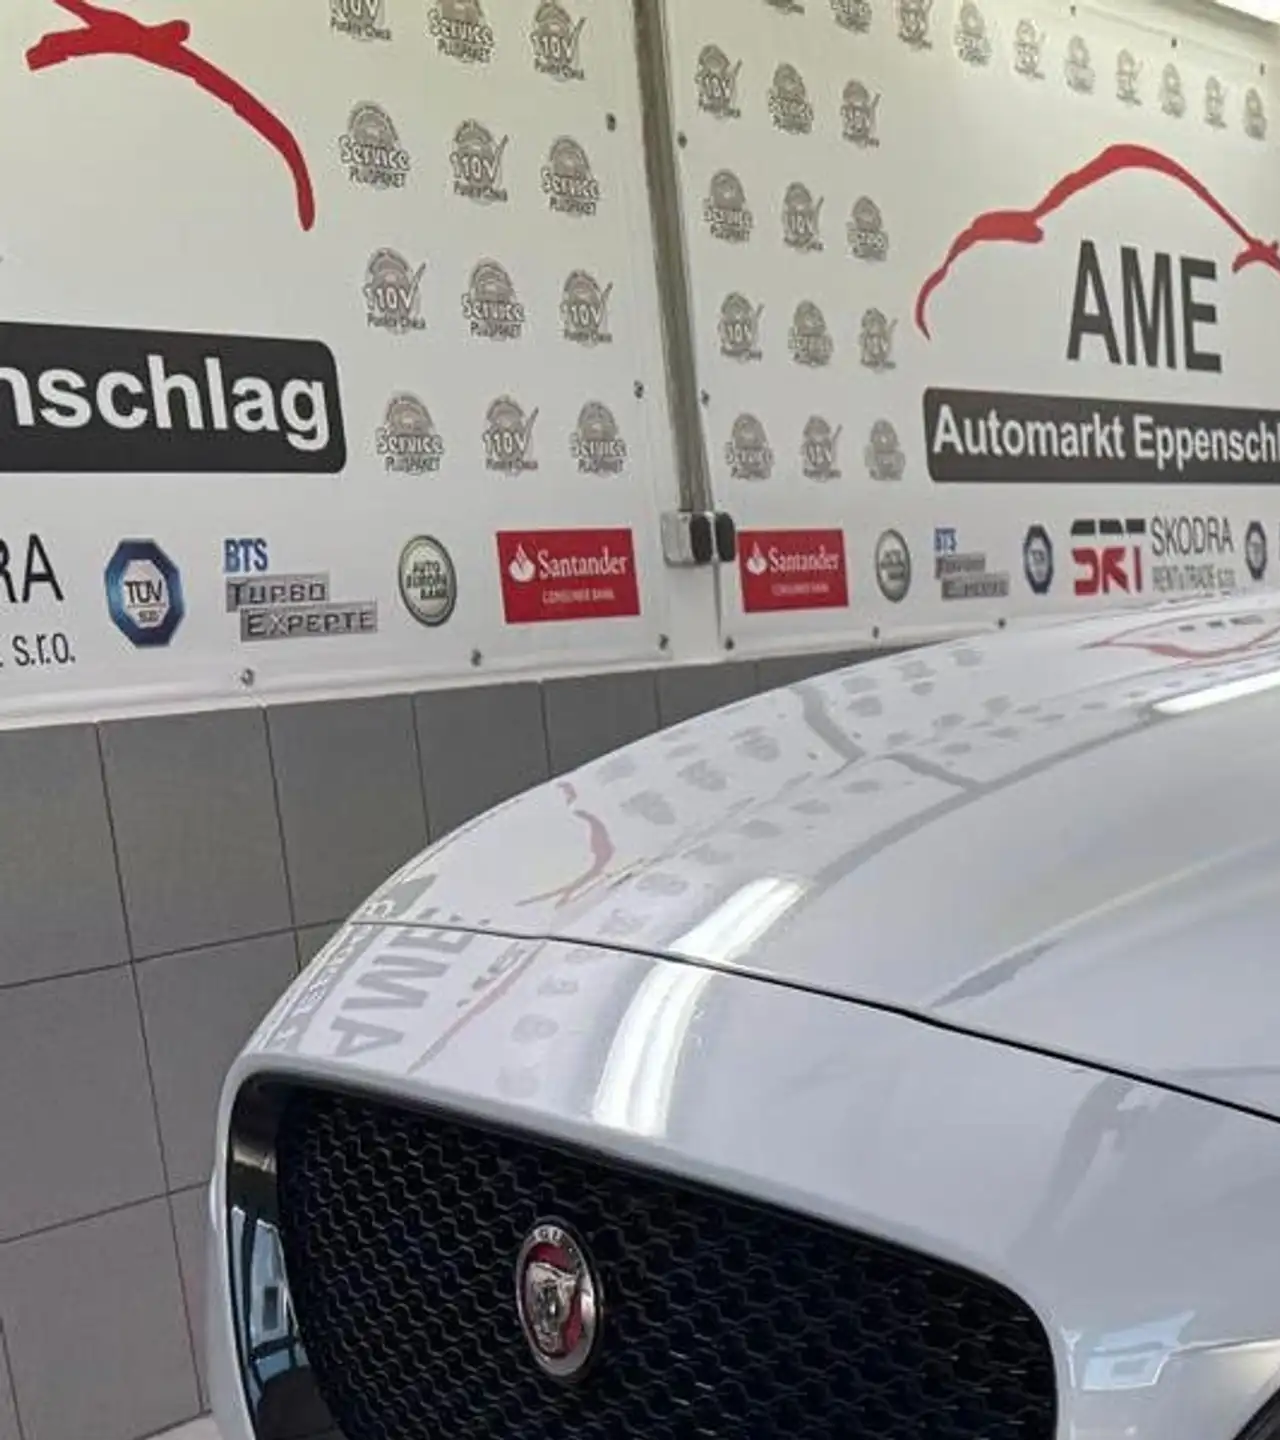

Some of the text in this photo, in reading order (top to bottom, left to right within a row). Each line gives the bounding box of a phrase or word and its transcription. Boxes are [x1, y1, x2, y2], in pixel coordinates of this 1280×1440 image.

[1067, 239, 1222, 373] AME
[0, 354, 329, 451] nschlag
[932, 404, 1126, 460] Automarkt
[224, 538, 268, 573] BTS
[537, 545, 628, 580] Santander
[768, 544, 839, 573] Santander
[12, 632, 76, 667] s.r.o.
